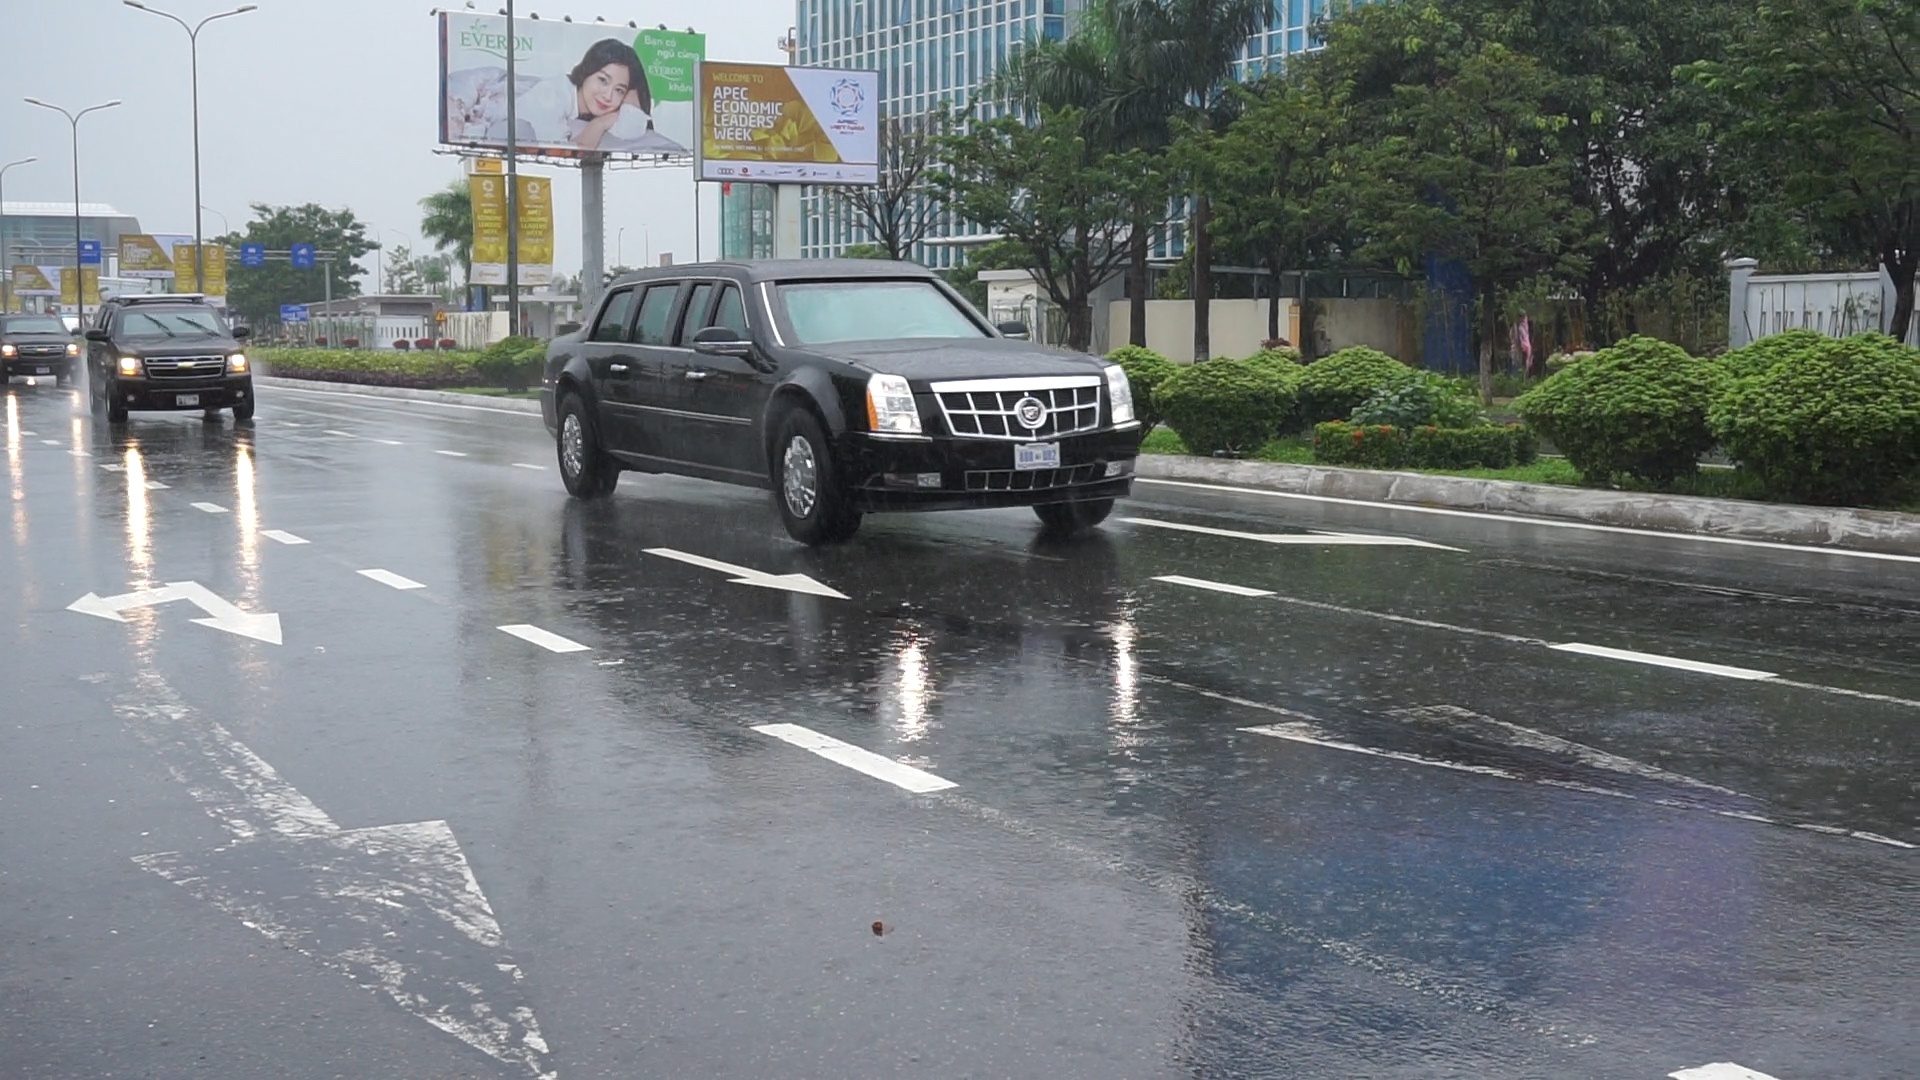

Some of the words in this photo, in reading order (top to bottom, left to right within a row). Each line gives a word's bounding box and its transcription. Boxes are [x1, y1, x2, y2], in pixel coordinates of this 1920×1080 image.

[712, 72, 750, 82] WELCOME
[751, 73, 764, 83] TO
[713, 86, 749, 100] APEC
[713, 100, 783, 116] ECONOMIC
[713, 114, 777, 129] LEADERS'
[713, 128, 752, 142] WEEK
